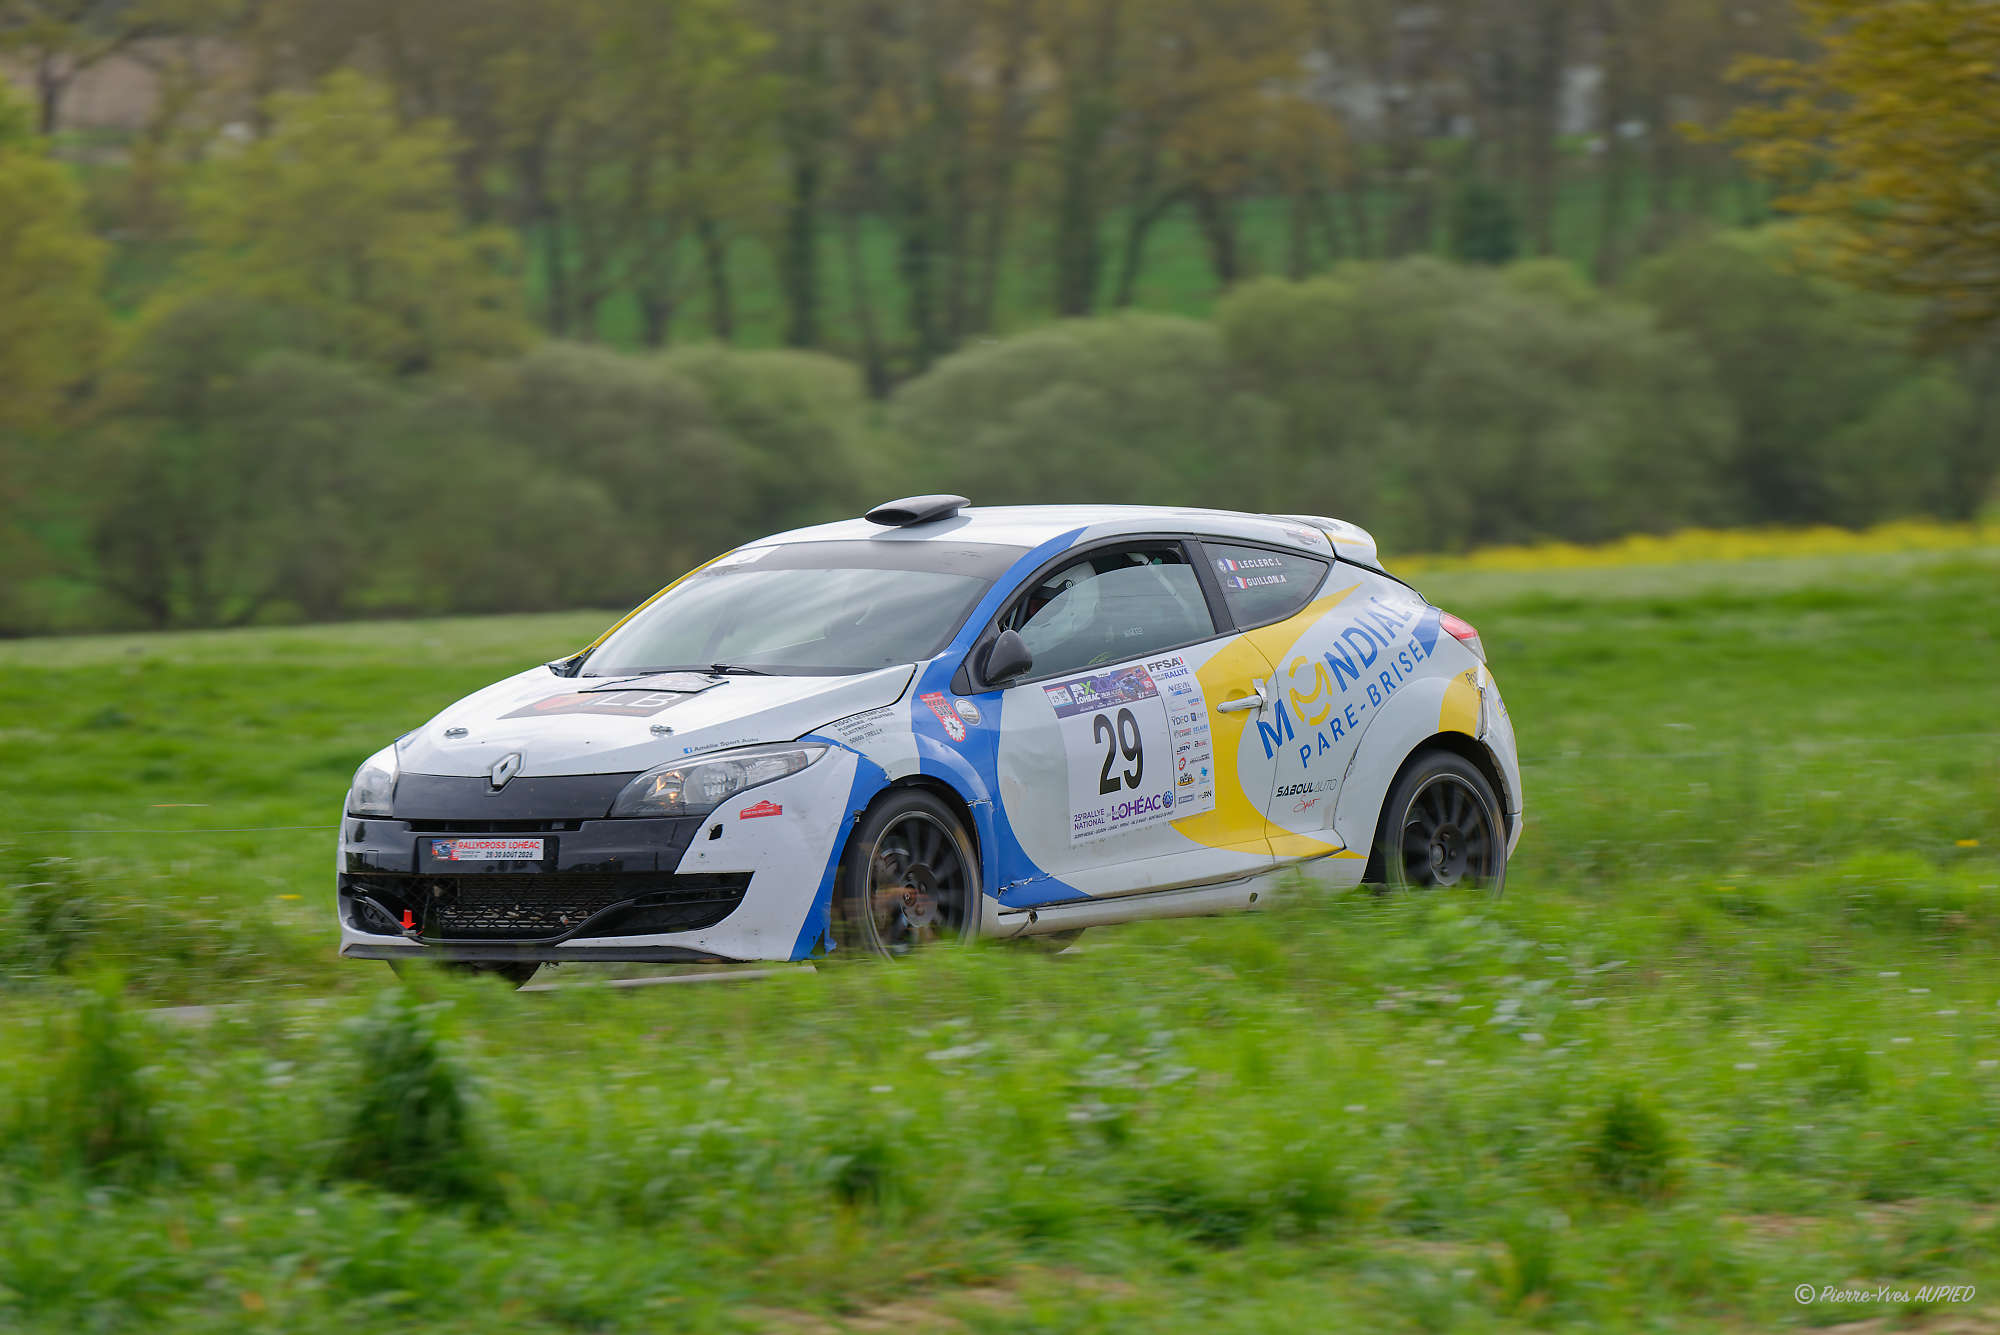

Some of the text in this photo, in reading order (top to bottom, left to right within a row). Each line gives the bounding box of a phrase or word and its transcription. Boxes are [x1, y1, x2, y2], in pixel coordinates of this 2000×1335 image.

[1238, 558, 1282, 569] LECLERC.L
[1147, 656, 1183, 673] FFSA
[1164, 667, 1189, 680] RALLYE
[1256, 596, 1415, 760] MONDIAL
[1299, 639, 1424, 768] PARE-BRISE
[1093, 707, 1144, 796] 29
[1111, 794, 1161, 821] LOHÉAC
[1074, 817, 1105, 831] NATIONAL
[458, 841, 507, 850] RALLYCROSS
